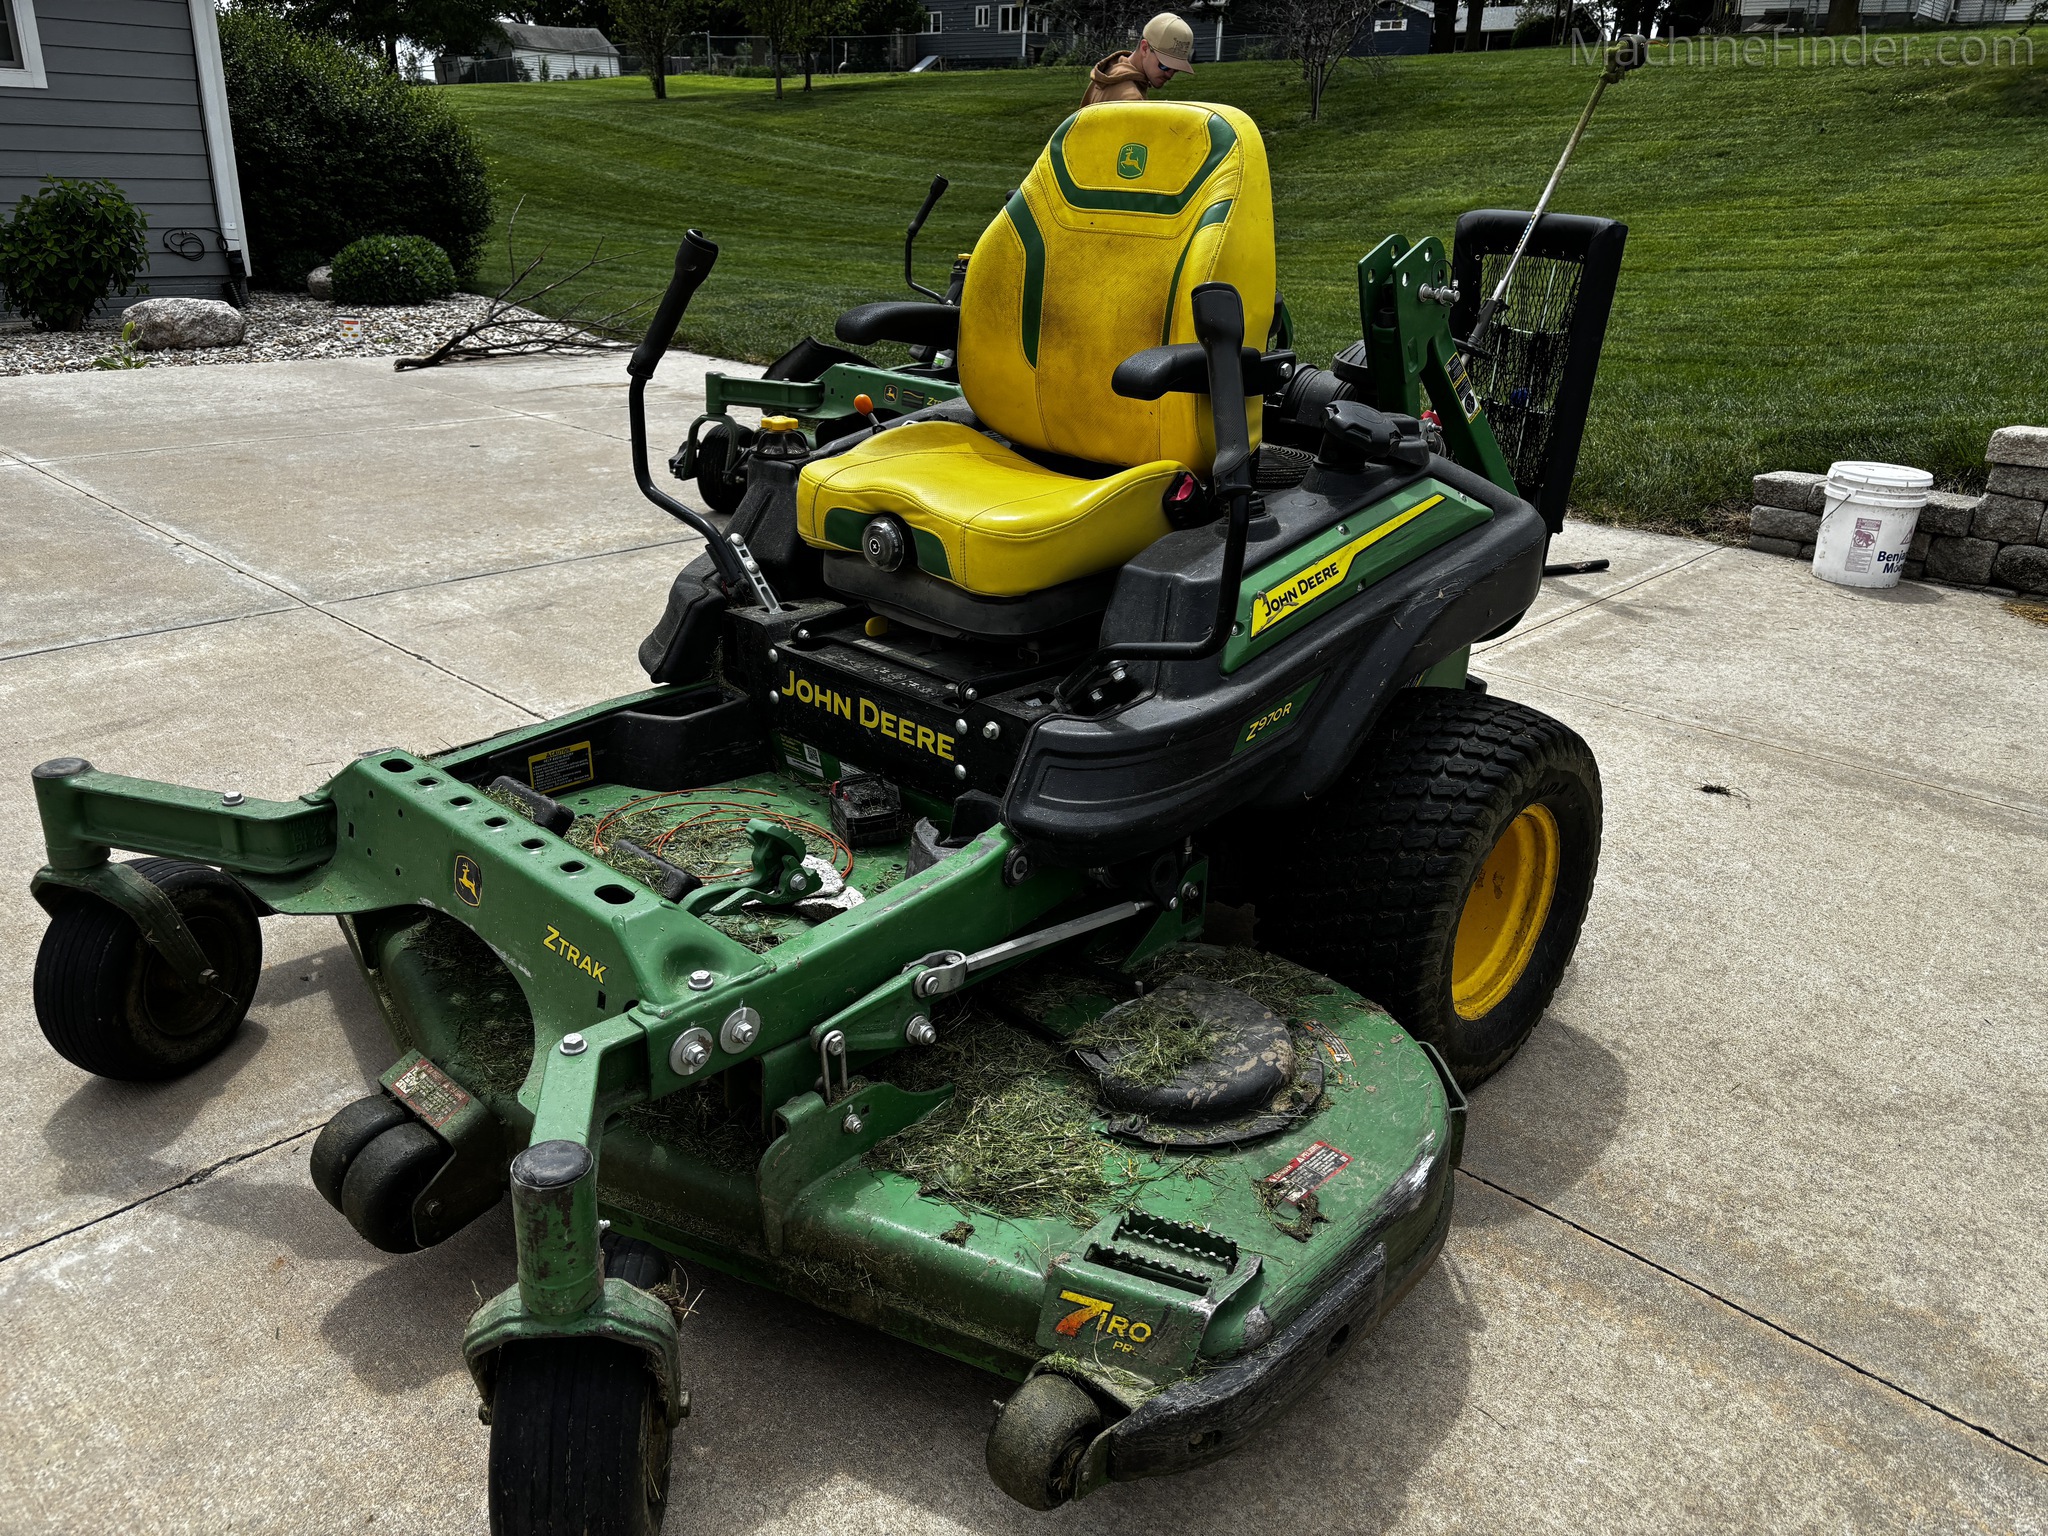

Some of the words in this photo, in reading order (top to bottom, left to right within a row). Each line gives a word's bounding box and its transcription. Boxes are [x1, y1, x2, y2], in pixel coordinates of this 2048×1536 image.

[1265, 587, 1299, 617] JOHN
[1299, 562, 1340, 595] DEERE
[782, 670, 851, 720] JOHN
[859, 697, 955, 762] DEERE
[1245, 702, 1292, 742] Z970R
[543, 924, 607, 984] ZTRAK
[1055, 1289, 1152, 1343] 7IRO
[1112, 1340, 1138, 1356] PR
